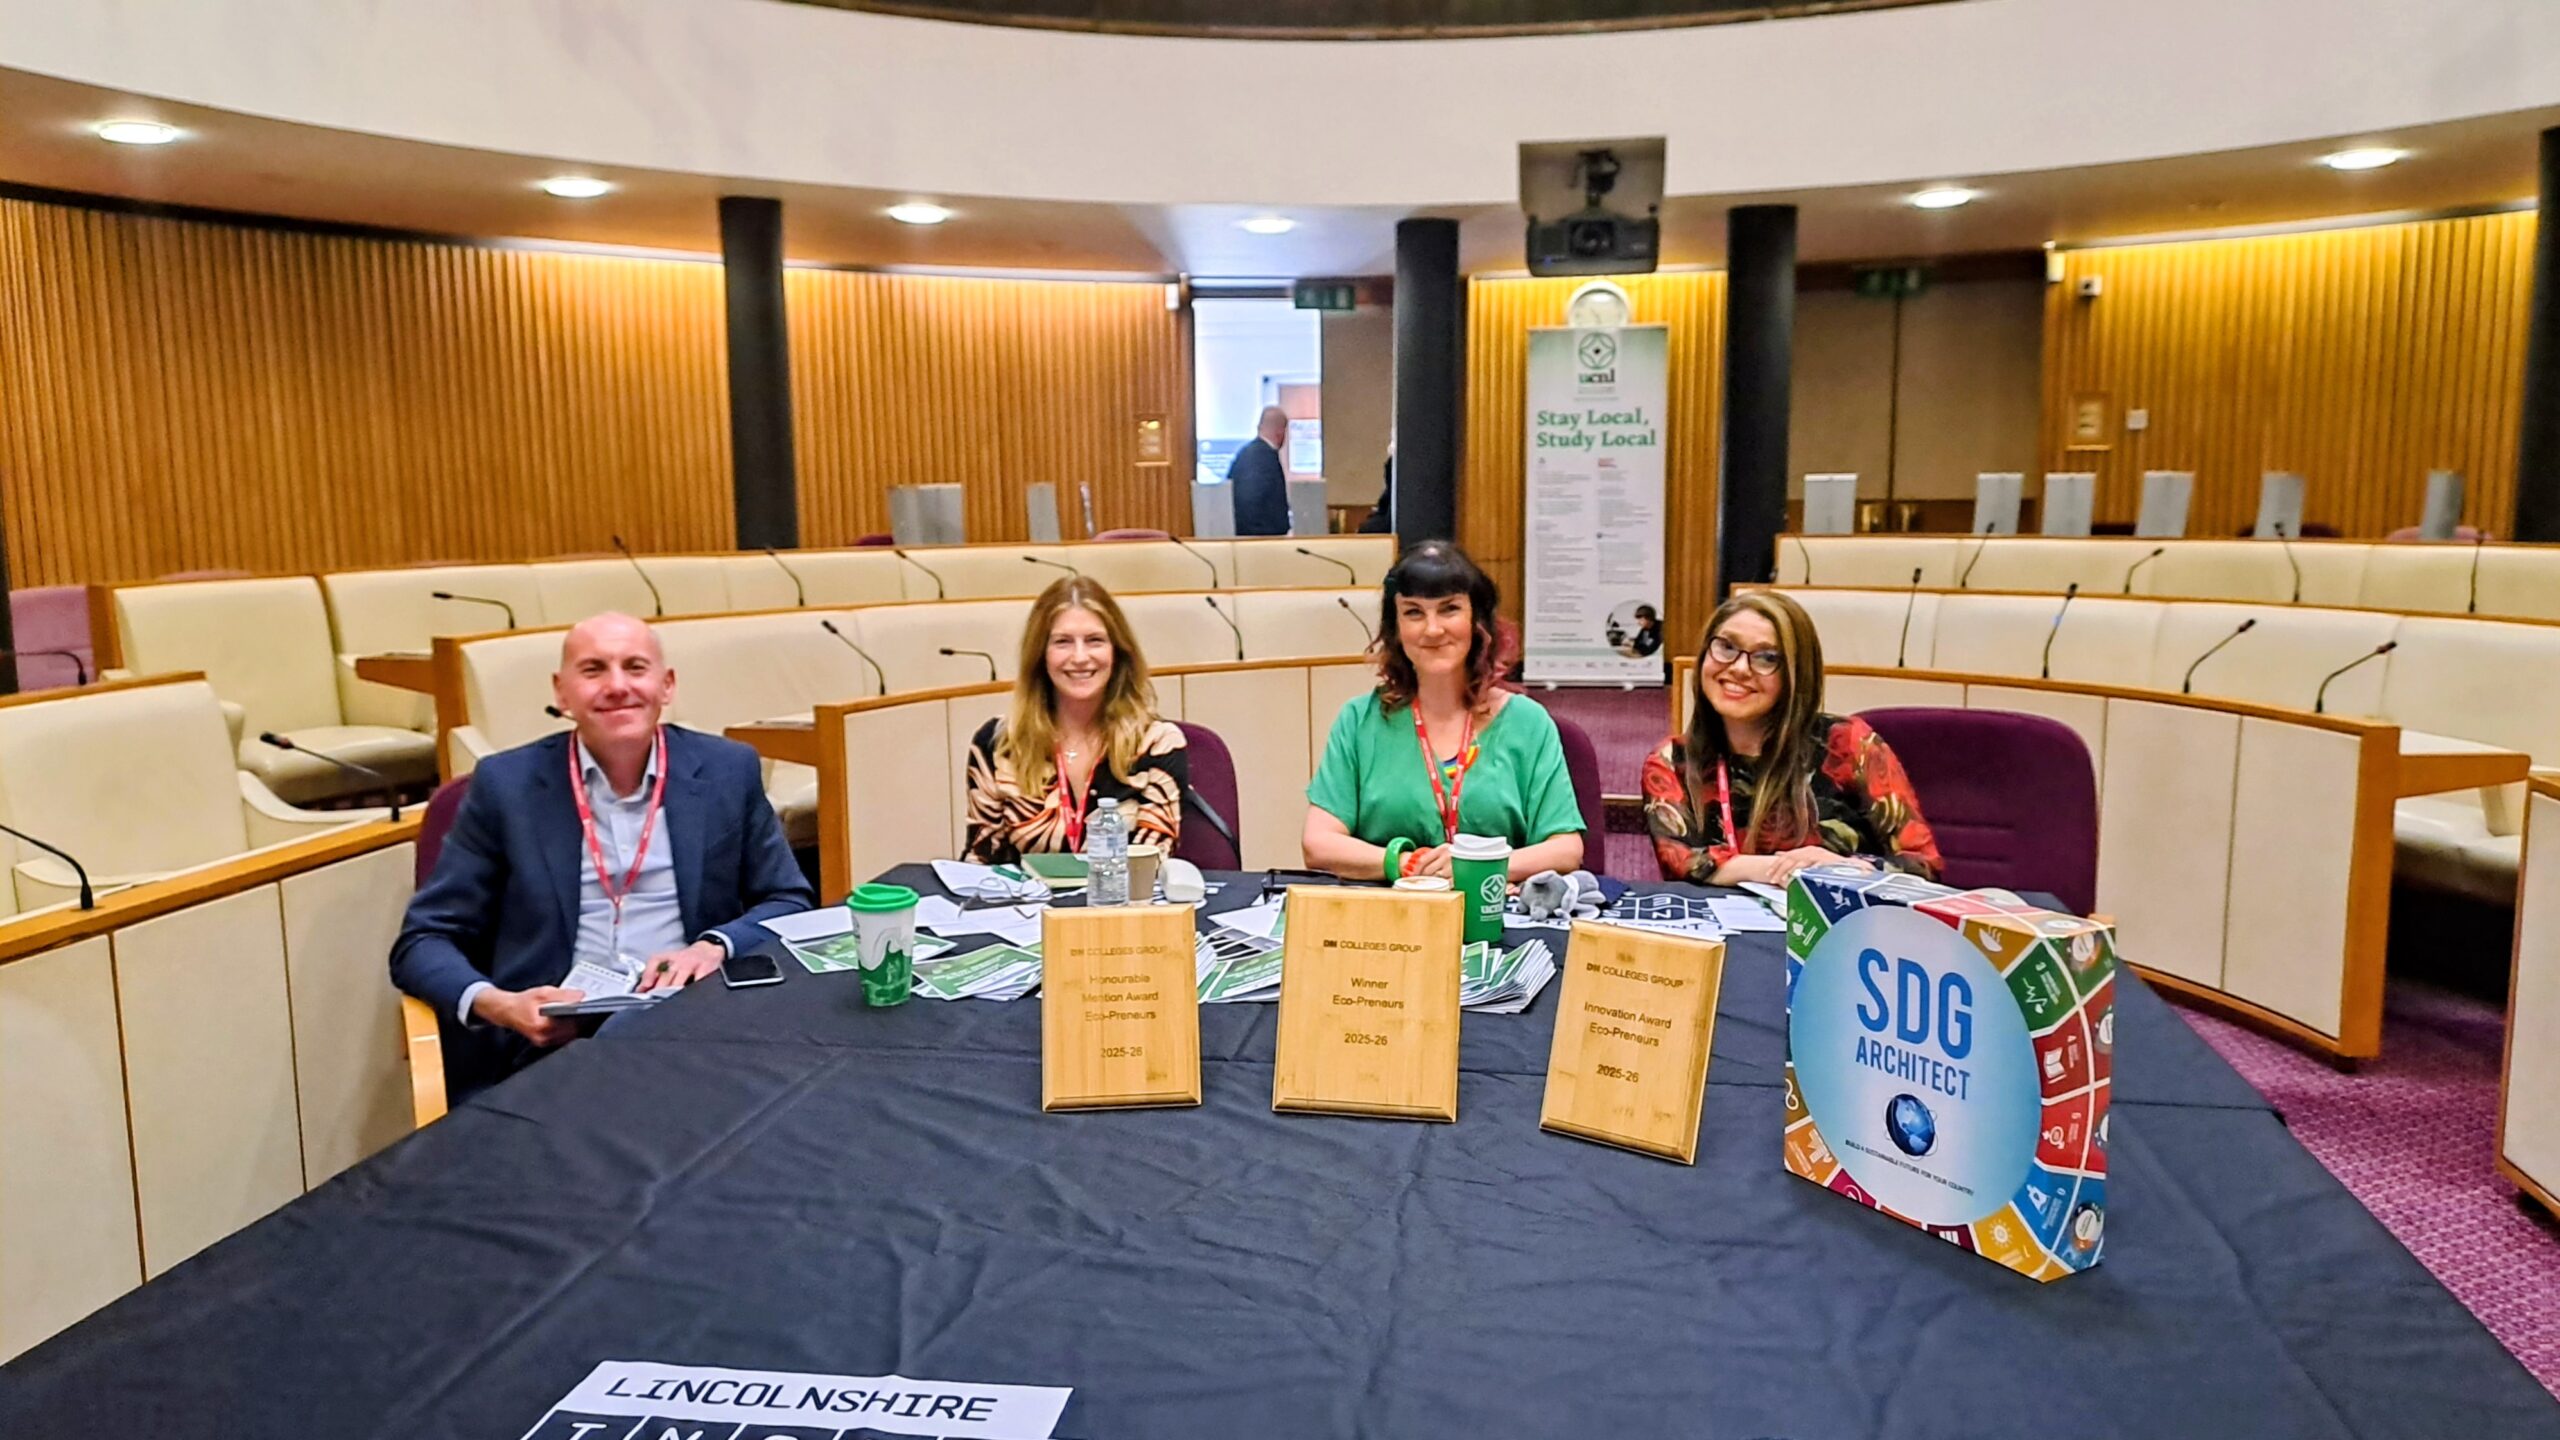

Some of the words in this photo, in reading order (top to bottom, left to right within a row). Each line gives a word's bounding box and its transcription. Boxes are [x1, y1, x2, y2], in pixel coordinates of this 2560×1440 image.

[1578, 368, 1616, 384] ucnl
[1537, 410, 1580, 431] Stay
[1586, 407, 1649, 425] Local,
[1536, 429, 1595, 452] Study
[1601, 429, 1656, 447] Local
[1087, 946, 1134, 955] COLLEGES
[1340, 941, 1387, 951] COLLEGES
[1389, 944, 1422, 953] GROUP
[1090, 975, 1151, 984] Honourable
[1351, 977, 1389, 990] Winner
[1602, 966, 1649, 982] COLLEGES
[1650, 975, 1684, 987] GROUP
[1082, 993, 1123, 1002] Mention
[1125, 992, 1159, 1001] Award
[1332, 995, 1404, 1009] Eco-Preneurs
[1856, 948, 1973, 1060] SDG
[1085, 1010, 1156, 1021] Eco-Preneurs
[1584, 1002, 1637, 1022] Innovation
[1638, 1013, 1672, 1029] Award
[1344, 1033, 1388, 1046] 2025-26
[1589, 1022, 1660, 1047] Eco-Preneurs
[1101, 1046, 1143, 1058] 2025-26
[1597, 1064, 1639, 1083] 2025-26
[1856, 1036, 1971, 1100] ARCHITECT
[605, 1377, 998, 1422] LINCOLNSHIRE
